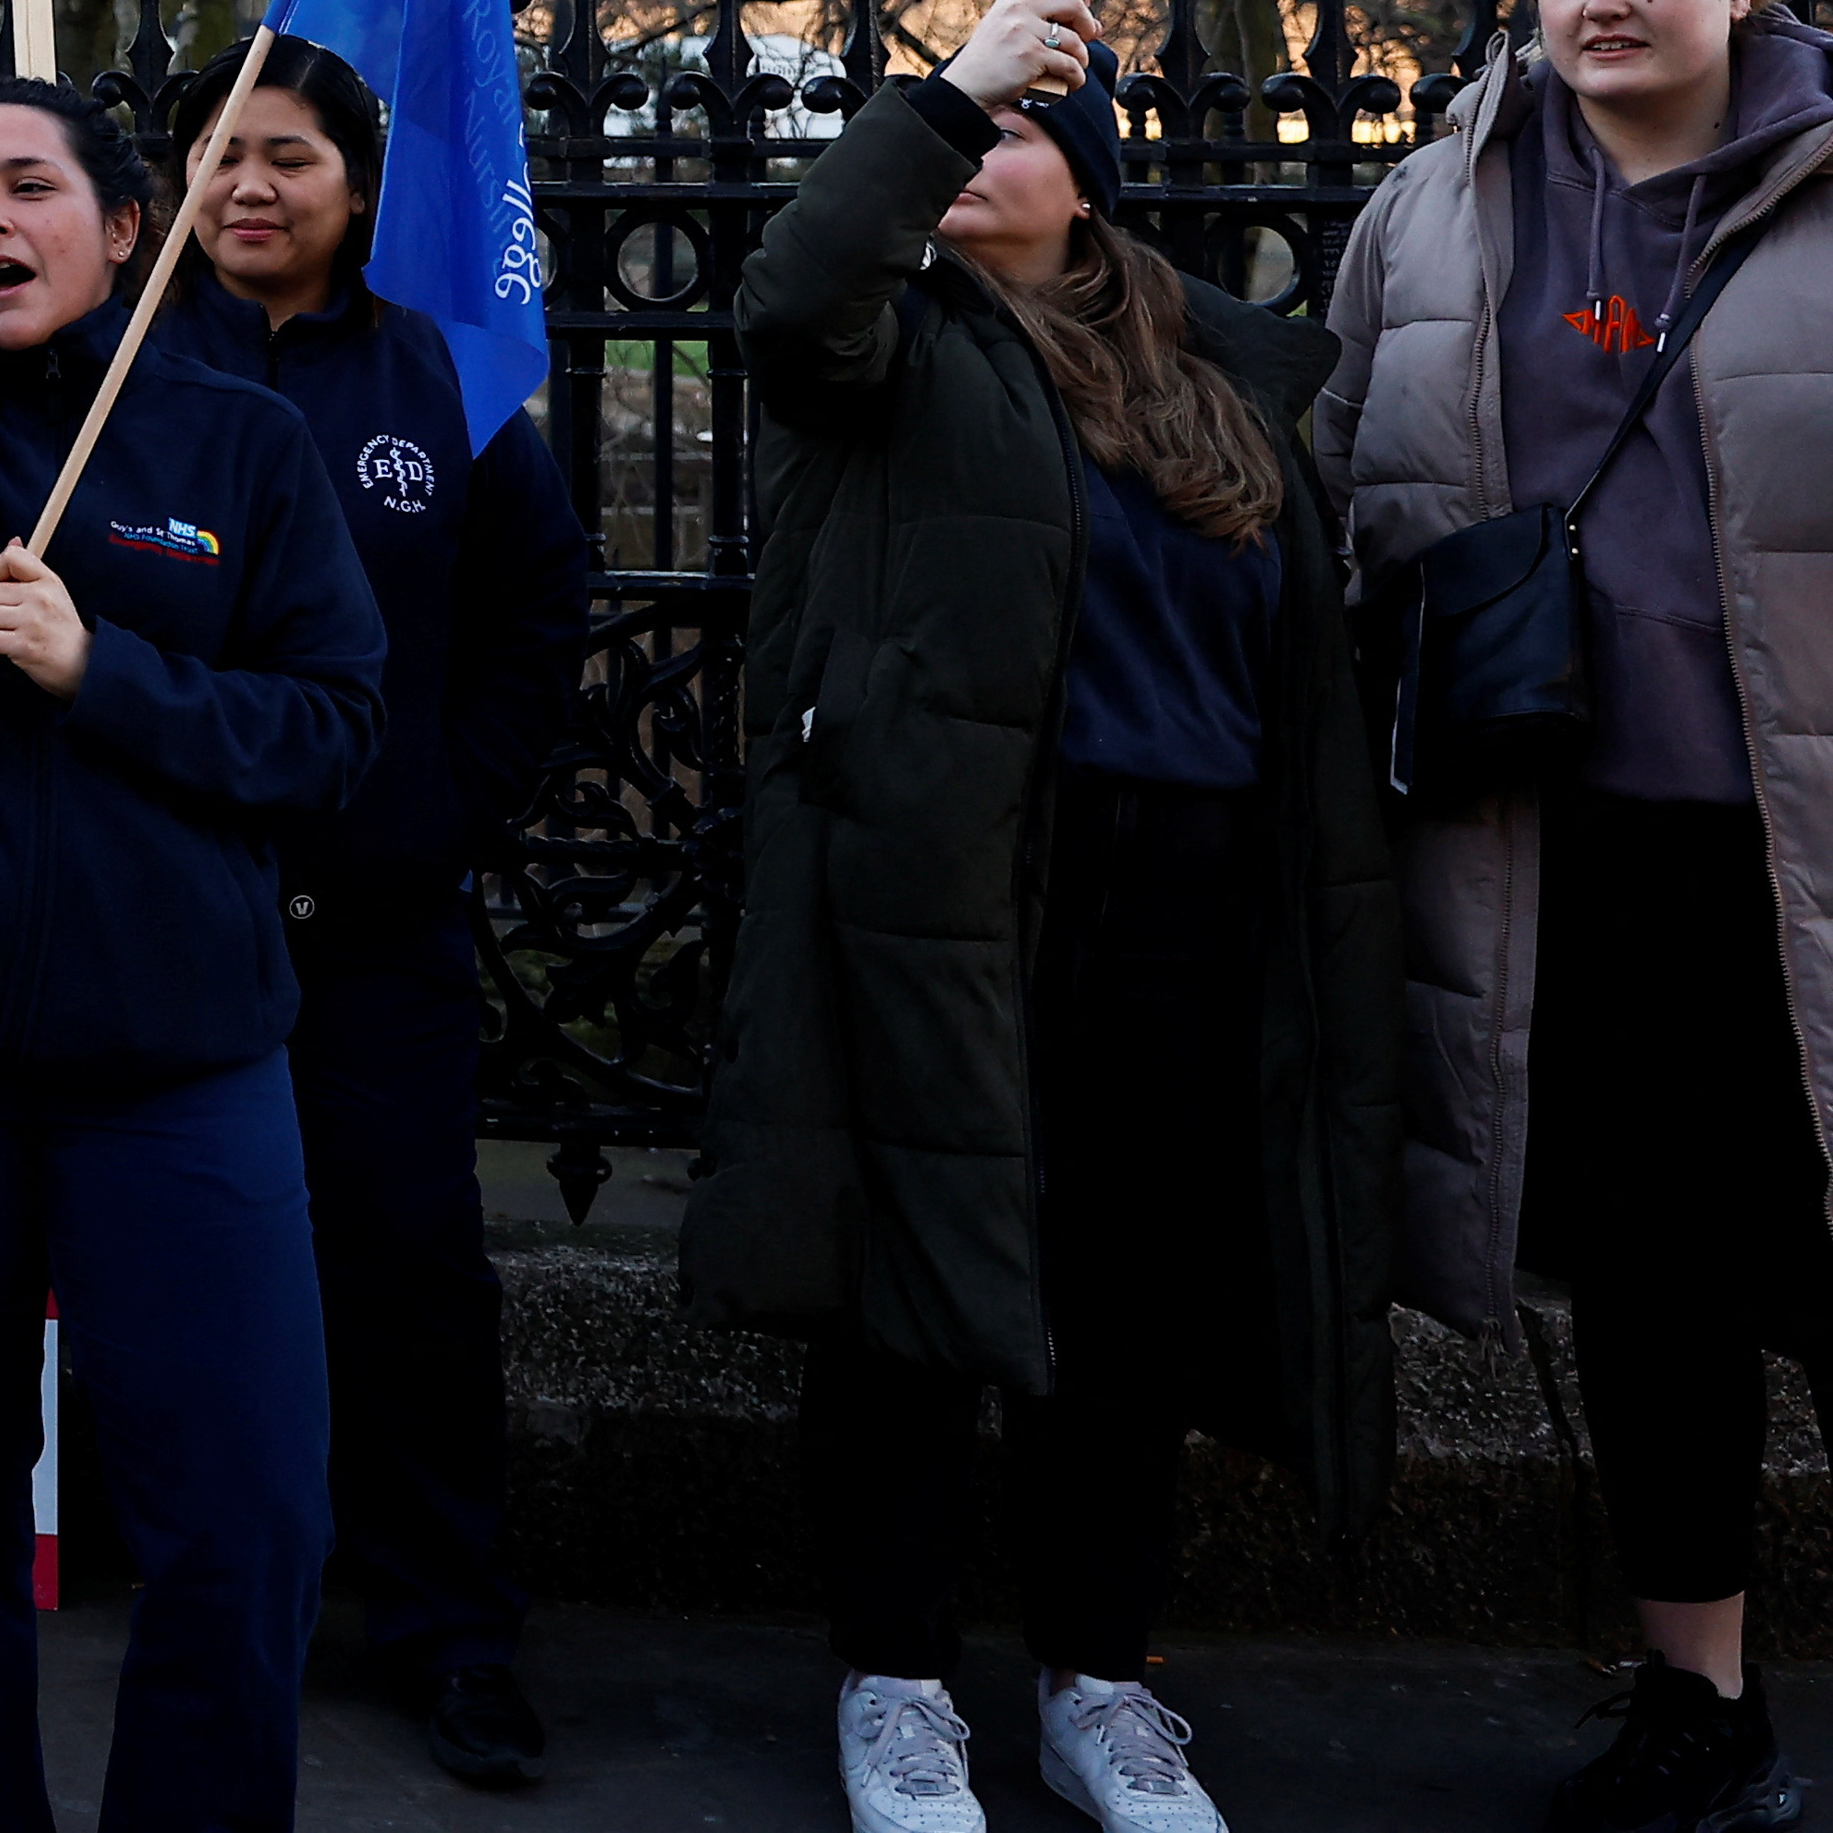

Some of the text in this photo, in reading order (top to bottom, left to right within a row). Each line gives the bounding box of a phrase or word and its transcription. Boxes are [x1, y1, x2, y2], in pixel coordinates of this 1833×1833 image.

[356, 434, 390, 489] EMERGENCY
[391, 437, 435, 497] DEPARTMENT
[168, 518, 196, 538] NHS
